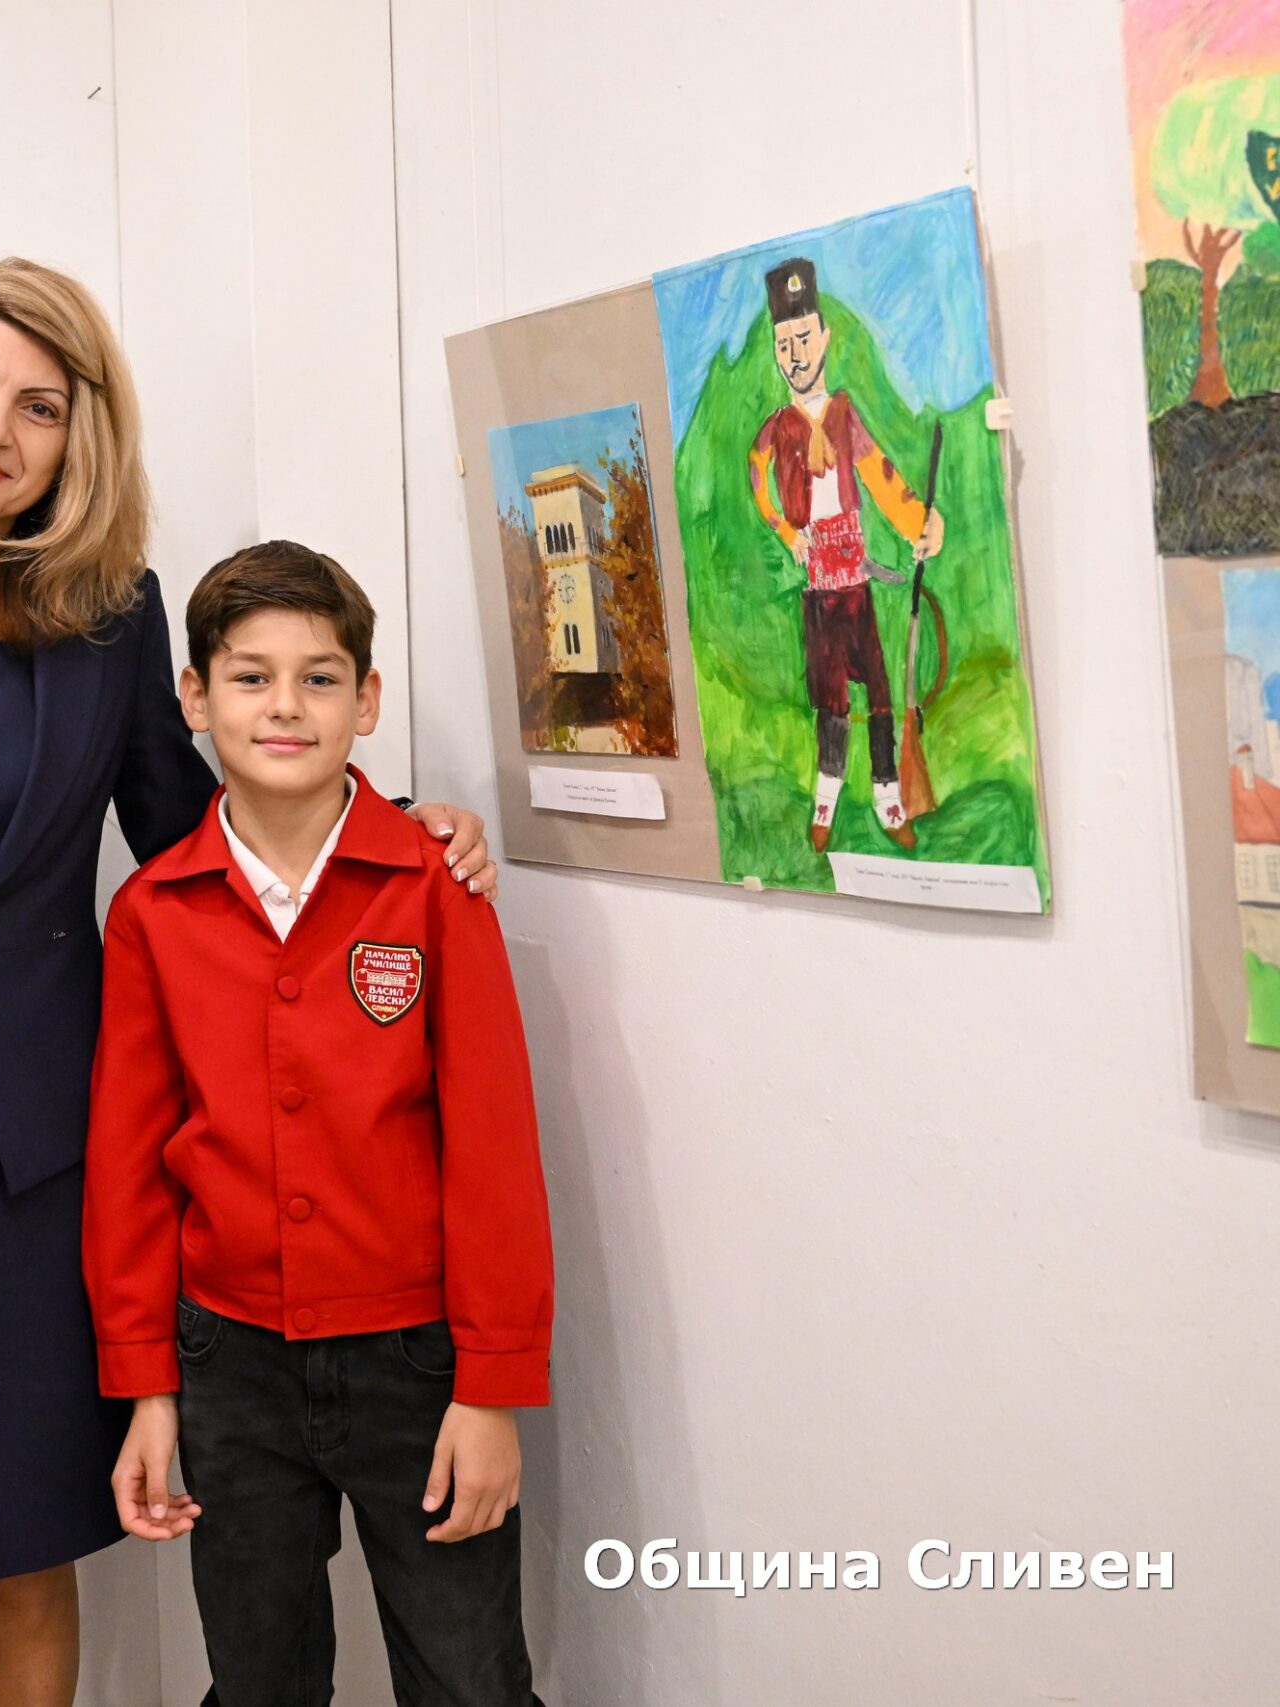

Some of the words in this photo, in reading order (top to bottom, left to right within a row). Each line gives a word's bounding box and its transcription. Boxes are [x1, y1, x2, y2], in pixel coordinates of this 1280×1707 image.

[365, 950, 411, 962] НАЧАЛНО
[363, 958, 412, 971] УЧИЛИЩЕ
[369, 985, 404, 997] ВАСИЛ
[365, 994, 406, 1006] ЛЕВСКИ
